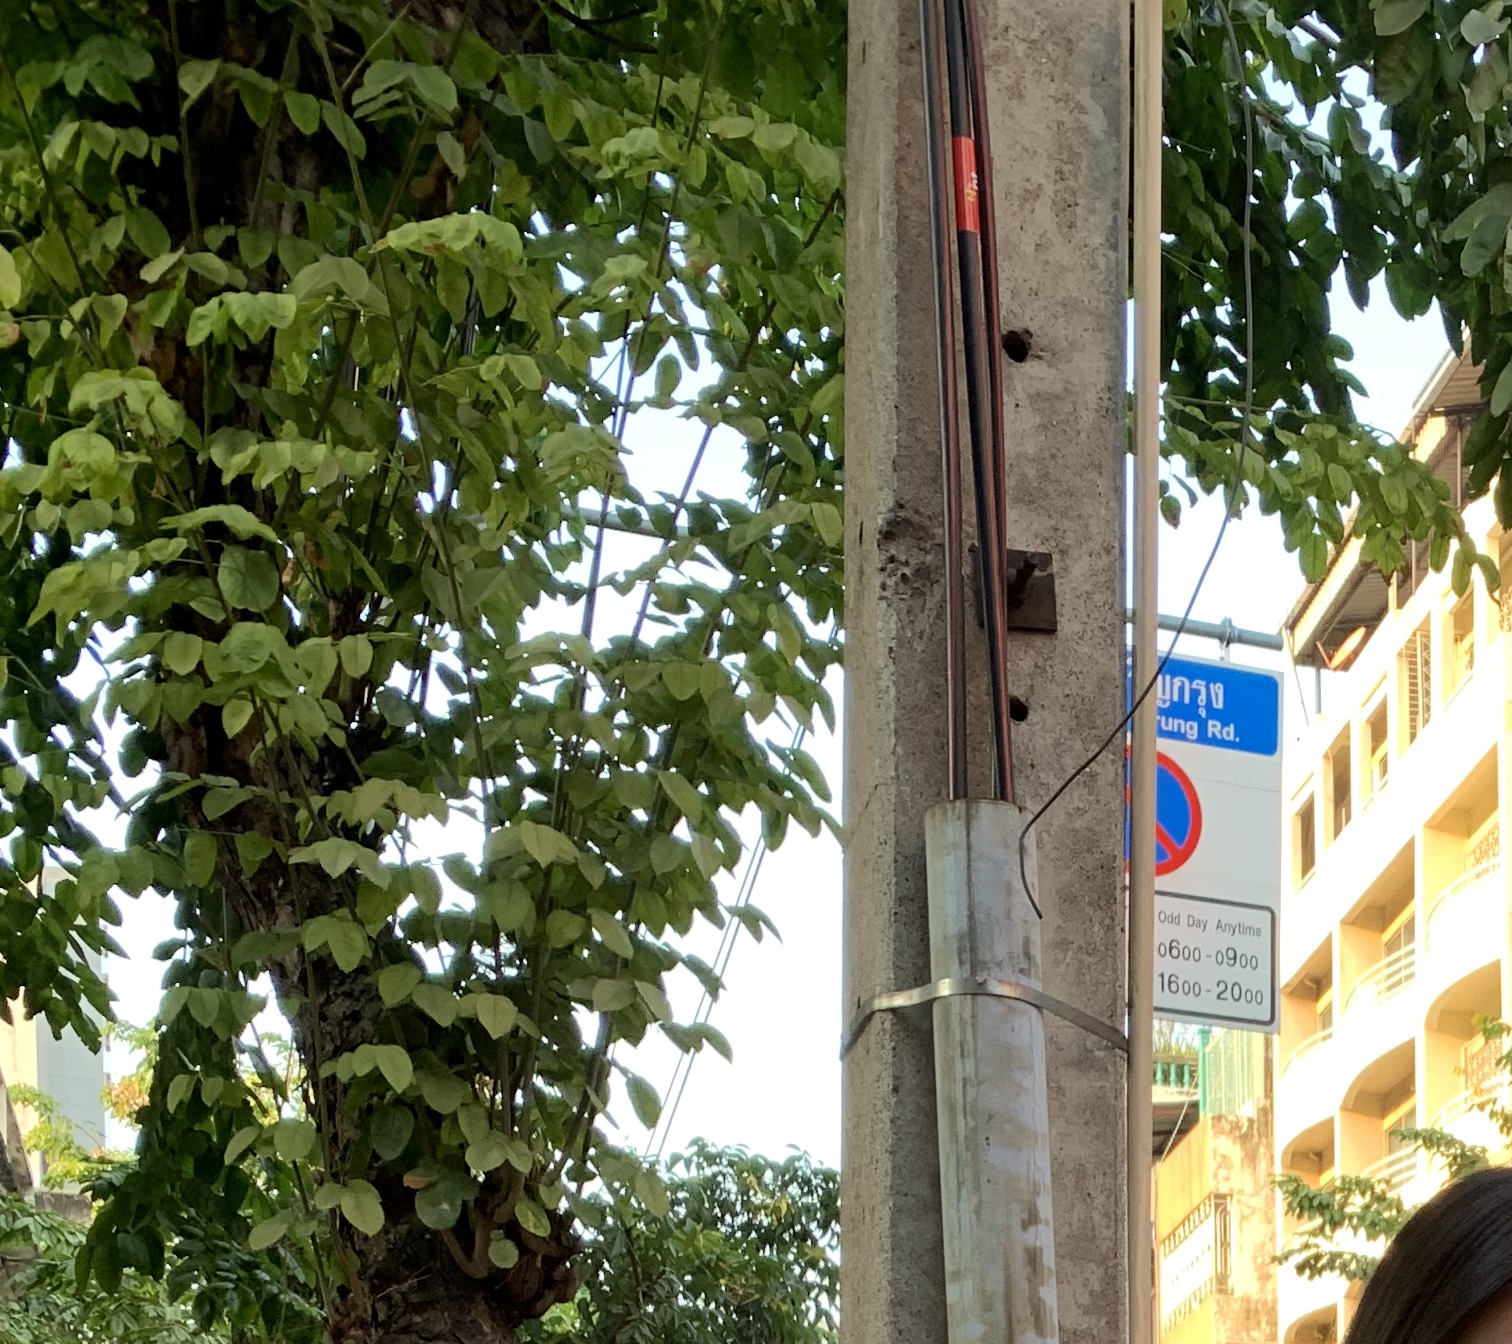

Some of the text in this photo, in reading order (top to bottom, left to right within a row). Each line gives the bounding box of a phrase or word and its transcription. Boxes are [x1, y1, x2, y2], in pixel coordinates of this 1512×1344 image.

[1157, 673, 1224, 718] ญกรุง
[1157, 715, 1241, 742] ung Rd.
[1158, 910, 1263, 937] Odd Day Anytime
